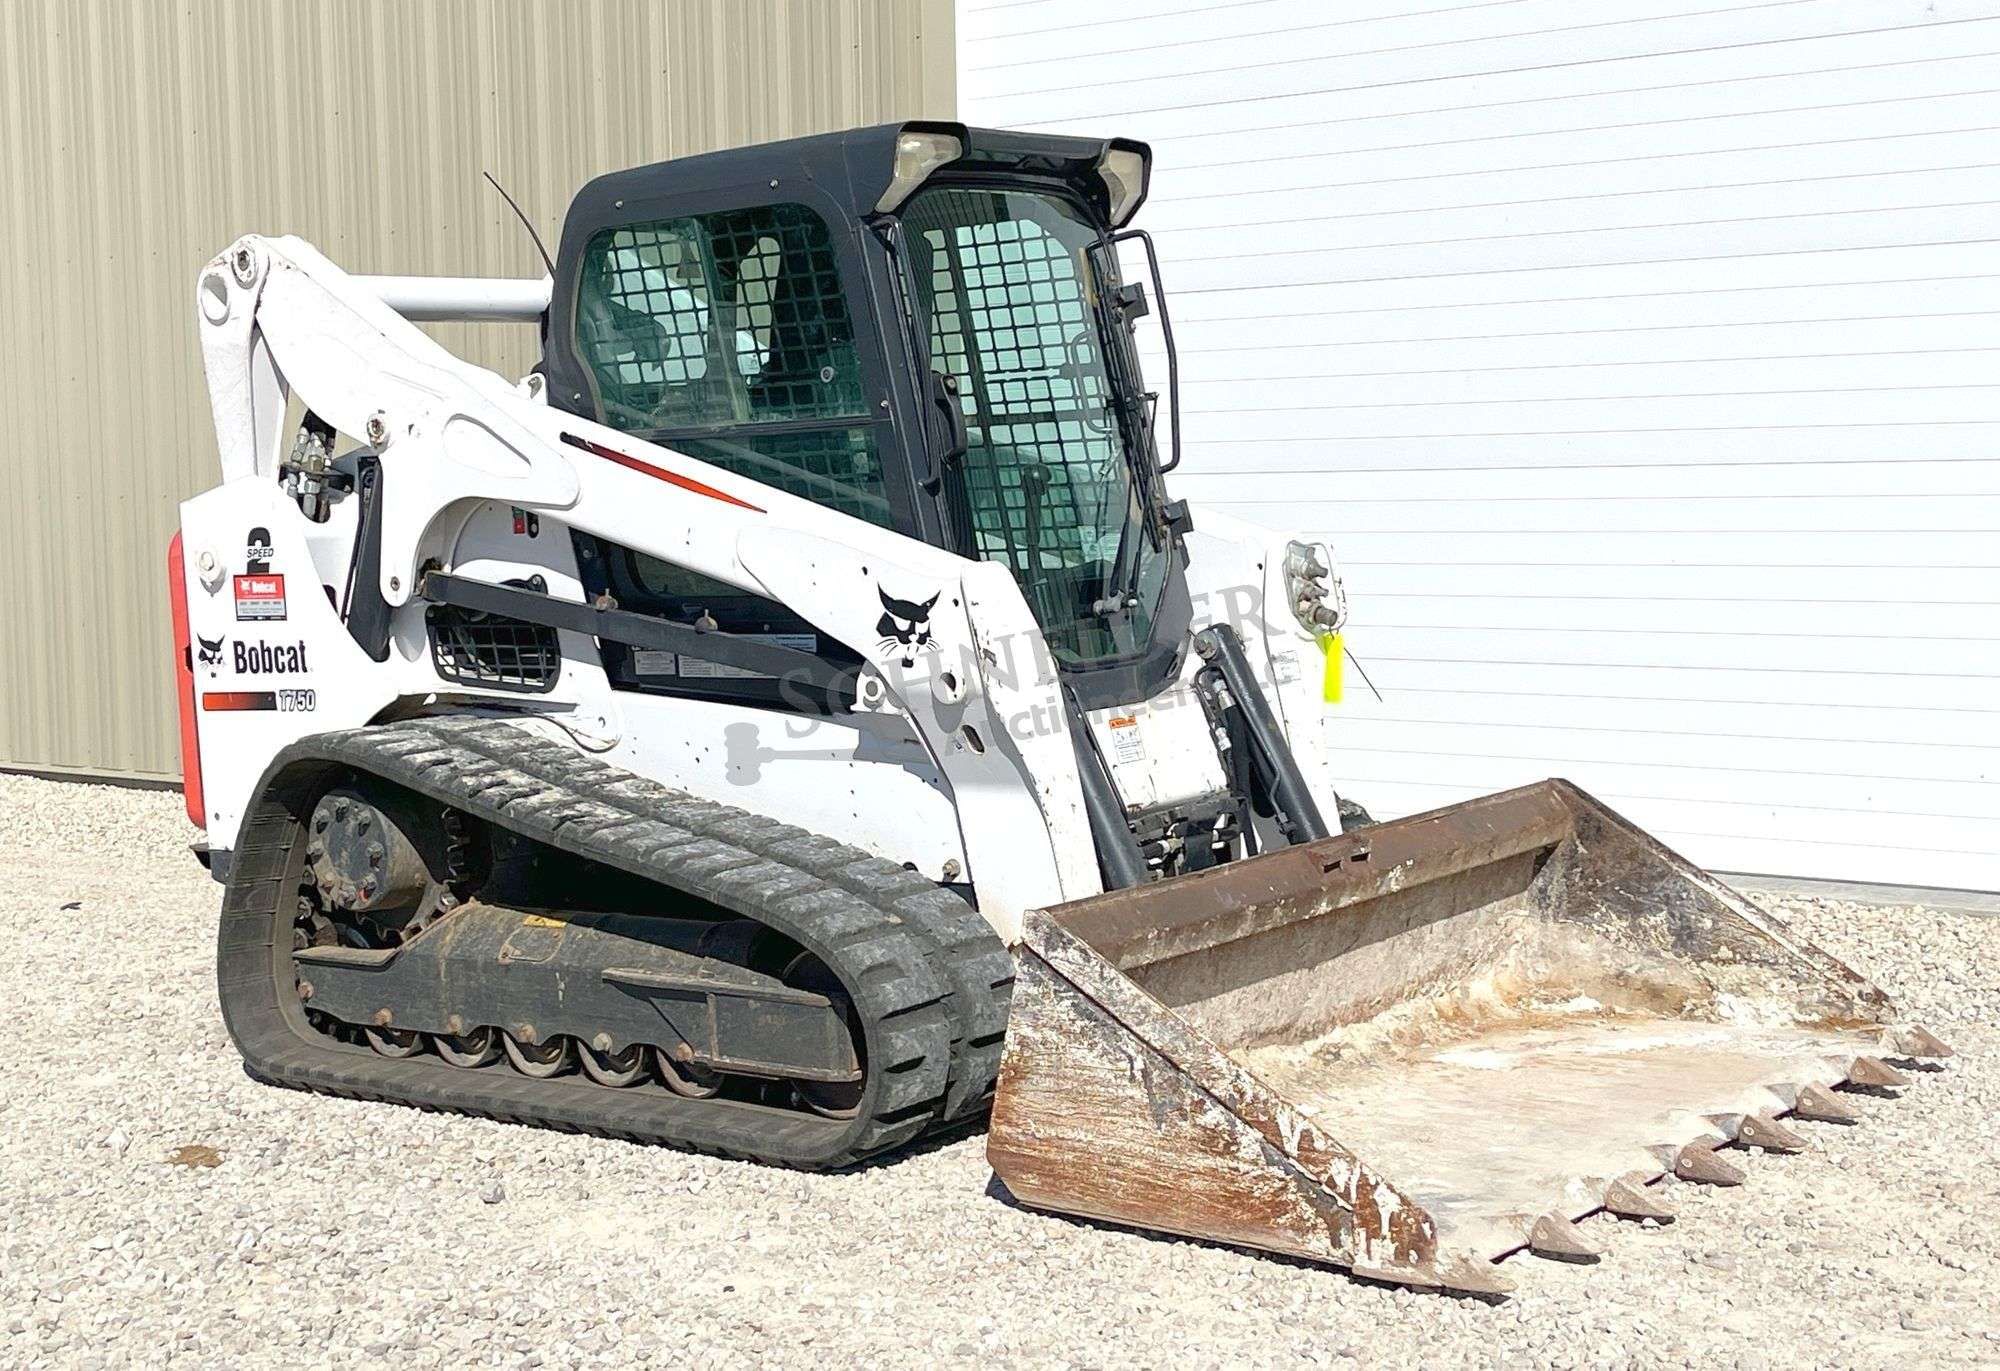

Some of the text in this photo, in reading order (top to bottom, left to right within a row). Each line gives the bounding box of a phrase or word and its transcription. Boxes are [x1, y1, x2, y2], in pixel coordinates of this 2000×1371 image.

[247, 548, 274, 558] SPEED
[233, 640, 307, 674] Bobcat
[279, 689, 316, 711] T750
